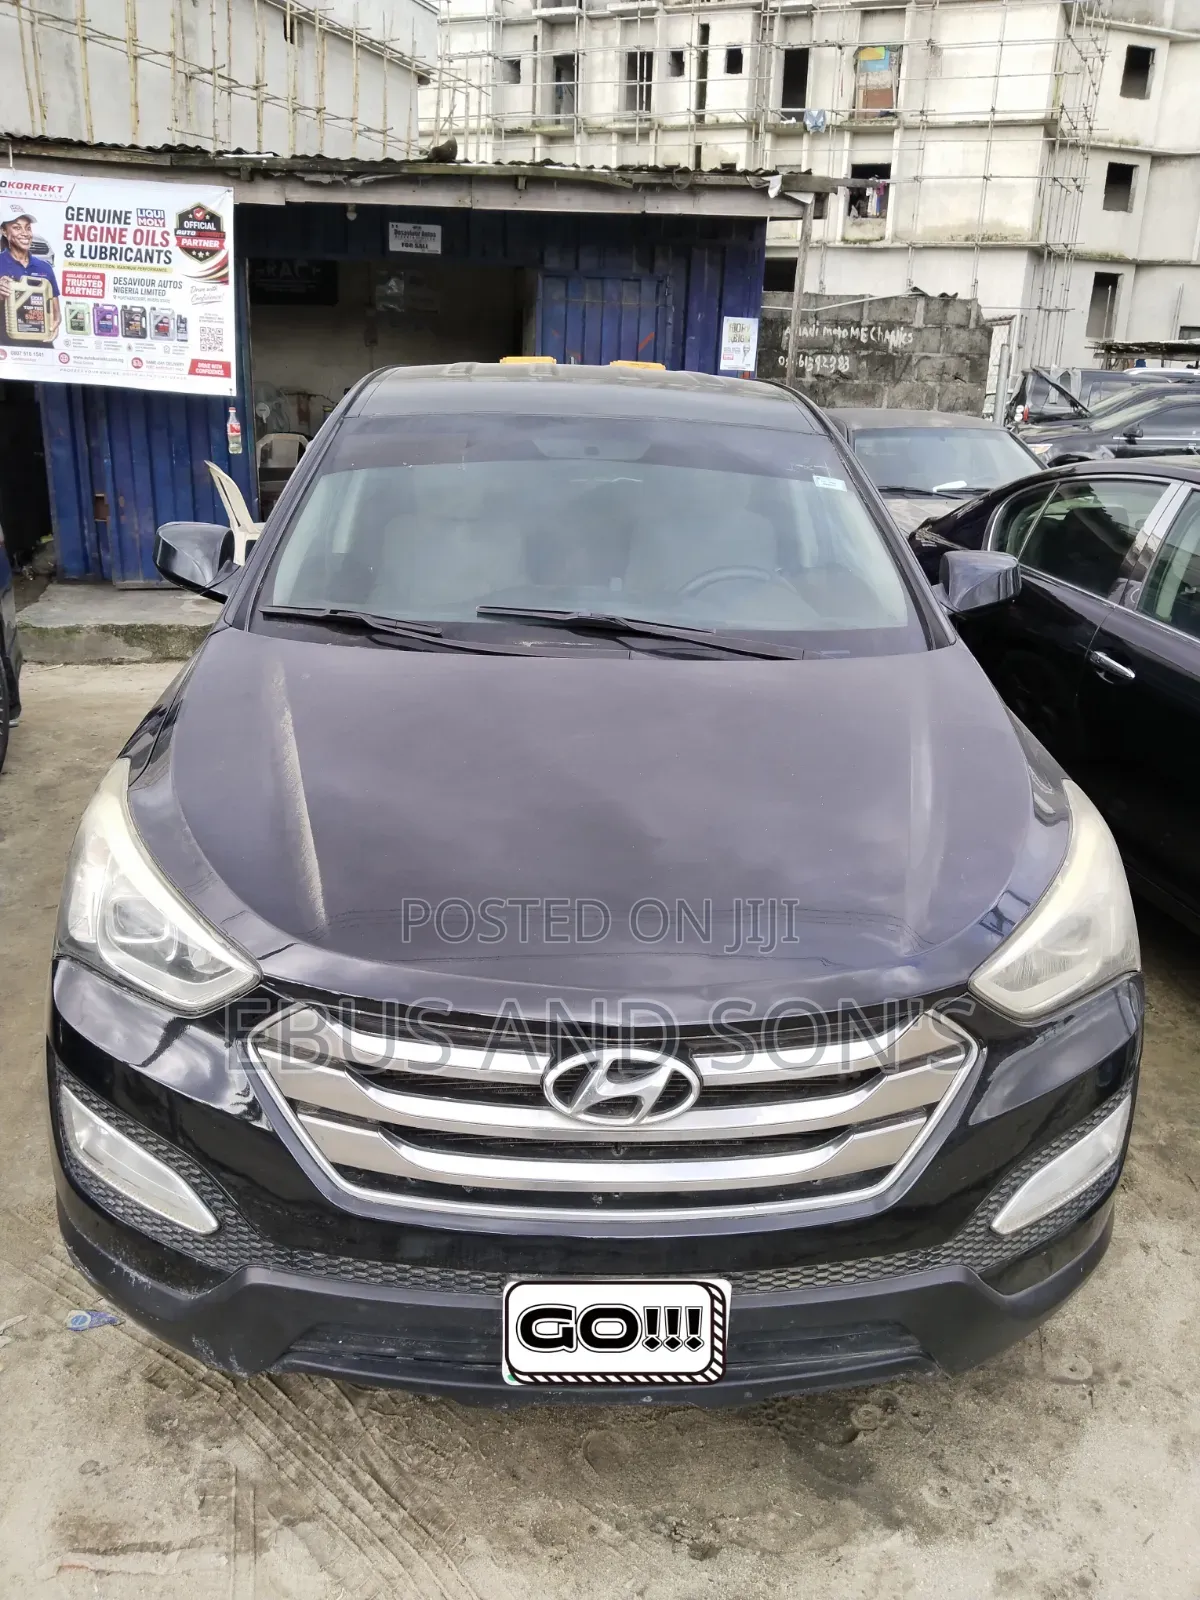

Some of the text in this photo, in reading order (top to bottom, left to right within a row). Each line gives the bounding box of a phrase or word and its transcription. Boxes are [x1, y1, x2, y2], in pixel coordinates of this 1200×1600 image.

[65, 206, 132, 225] GENUINE
[138, 209, 164, 218] LIQUI
[138, 218, 166, 227] MOLY
[184, 221, 216, 230] OFFICIAL
[63, 224, 170, 247] ENGINE OILS
[181, 239, 220, 247] PARTNER
[64, 243, 172, 264] & LUBRICANTS
[66, 279, 103, 288] TRUSTED
[113, 277, 183, 290] DESAVIOUR AUTOS
[65, 287, 103, 297] PARTNER
[113, 287, 166, 297] NIGERIA LIMITED
